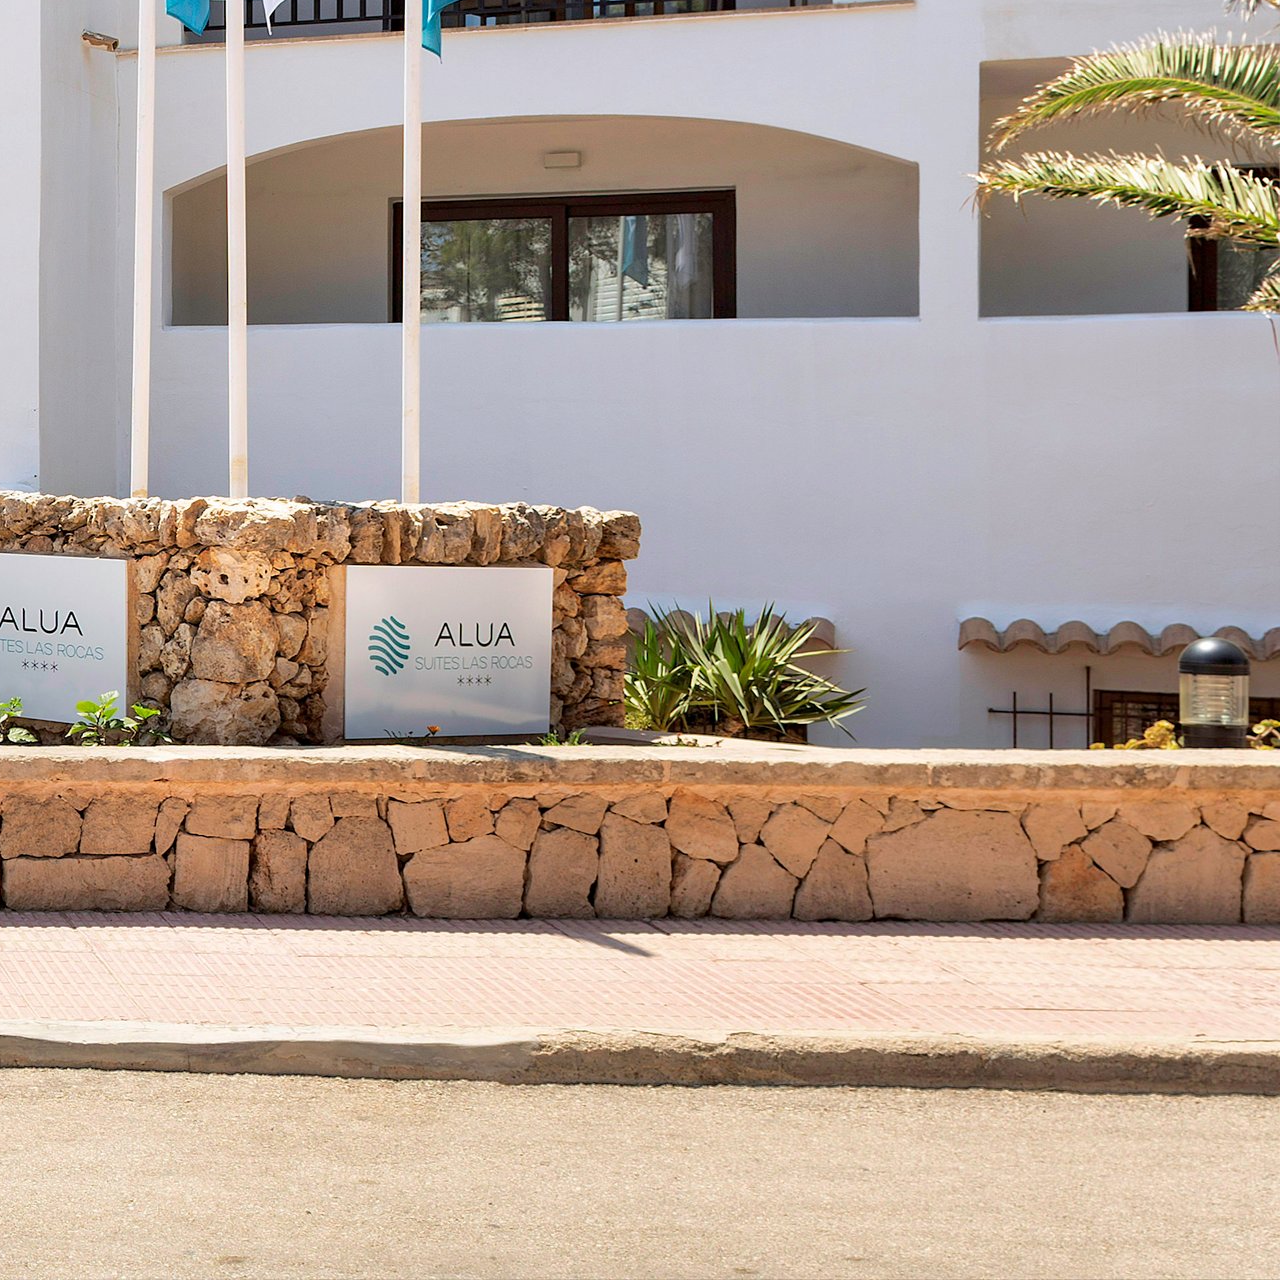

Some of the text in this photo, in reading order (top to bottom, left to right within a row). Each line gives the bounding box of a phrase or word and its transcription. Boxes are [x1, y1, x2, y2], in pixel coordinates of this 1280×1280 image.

[434, 622, 516, 648] ALUA
[26, 642, 53, 656] LAS
[57, 643, 105, 661] ROCAS
[415, 655, 534, 671] SUITES LAS ROCAS
